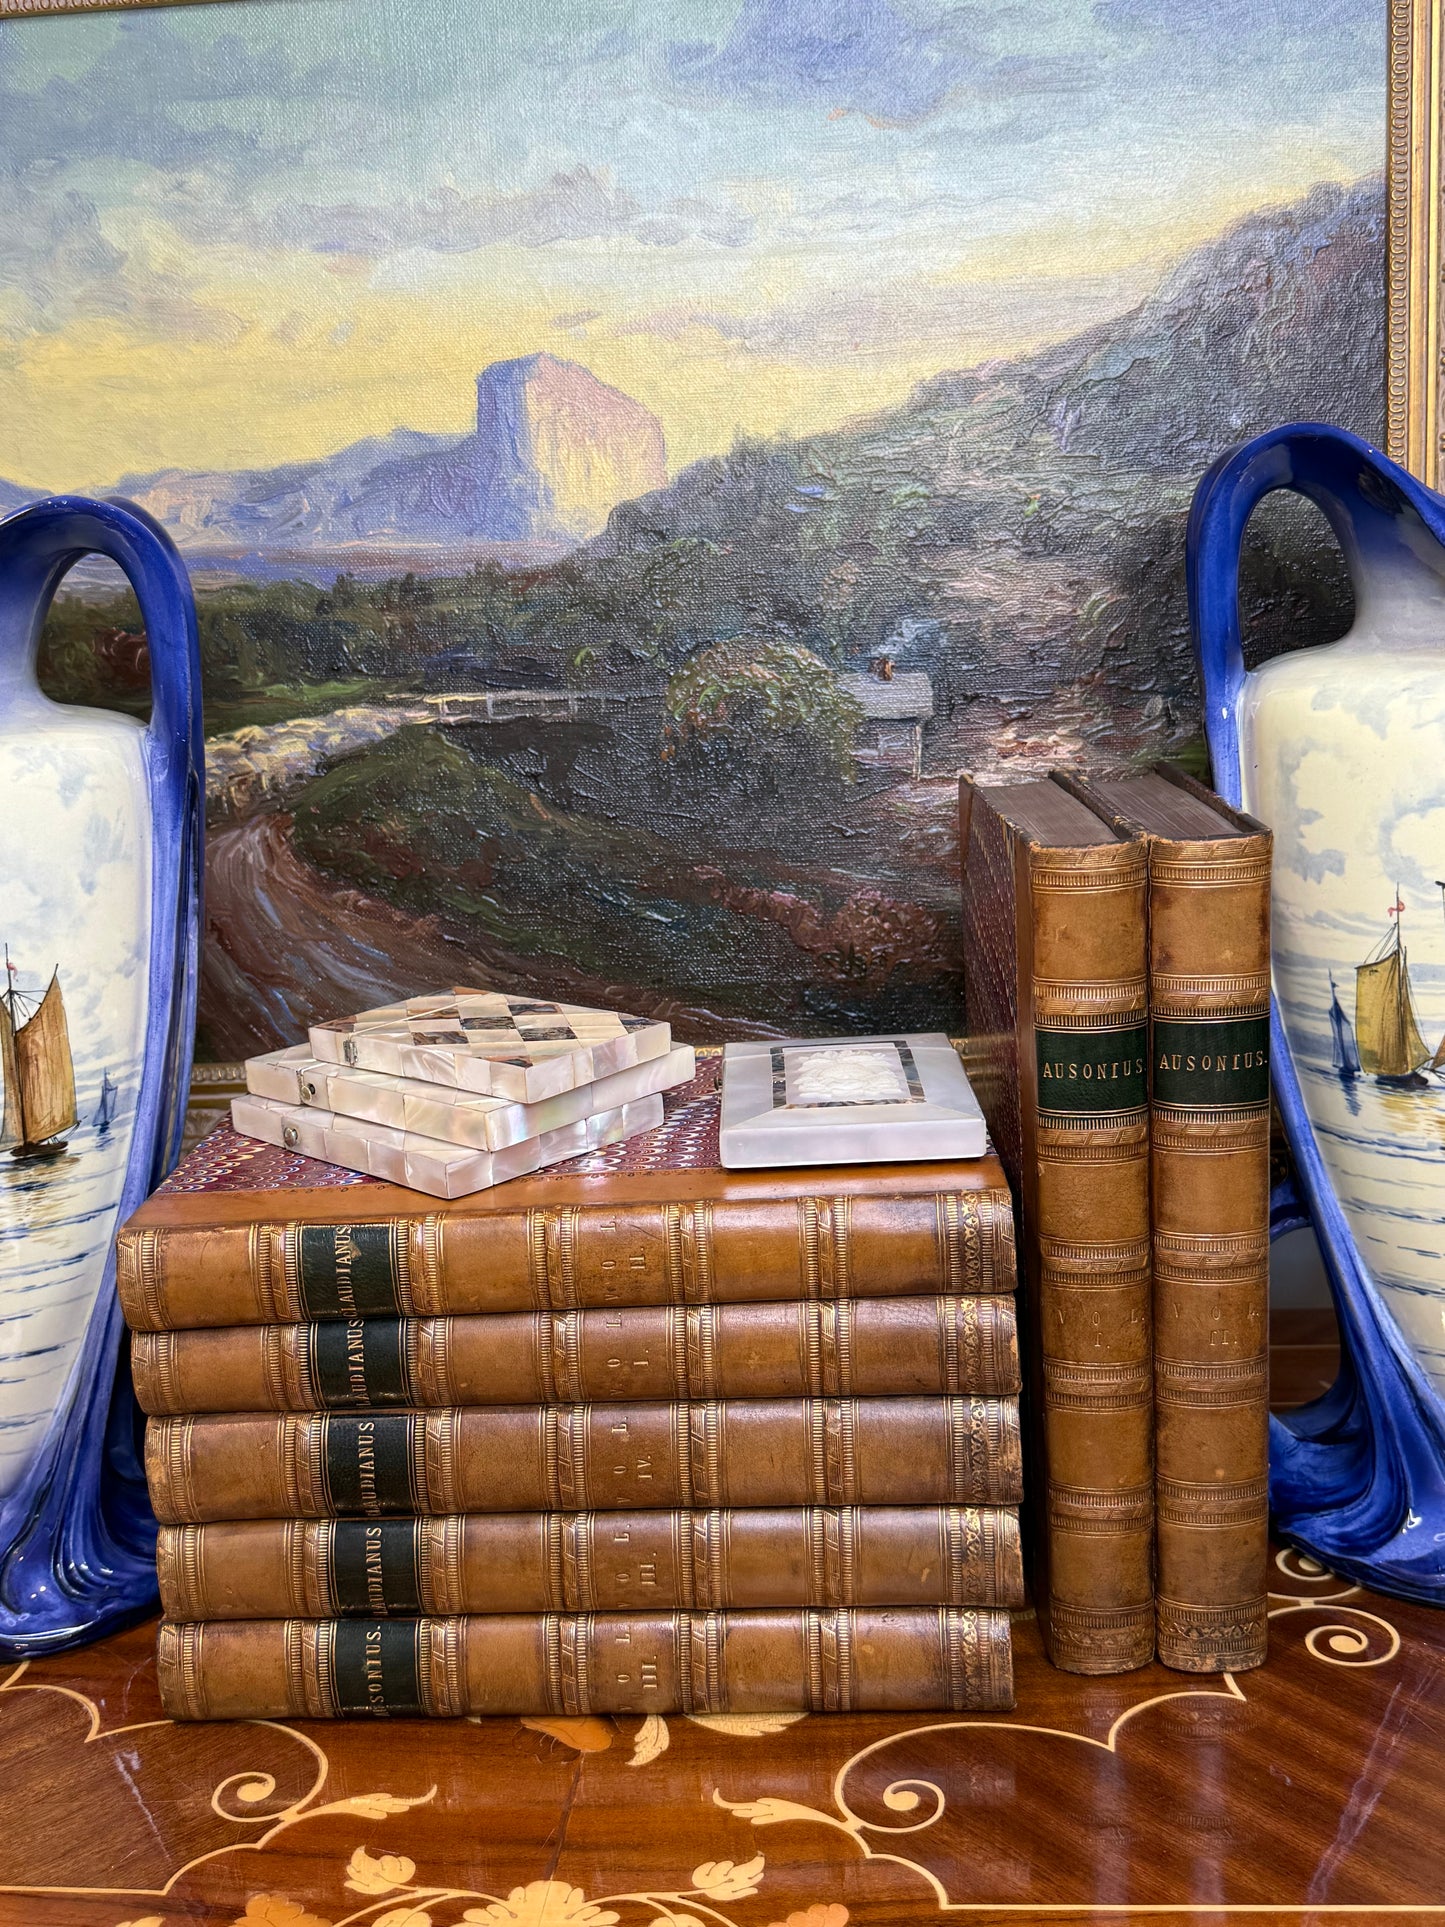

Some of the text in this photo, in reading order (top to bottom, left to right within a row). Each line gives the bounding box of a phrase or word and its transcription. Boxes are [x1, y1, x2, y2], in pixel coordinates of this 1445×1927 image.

[1043, 1058, 1147, 1079] AUSONIUS.
[1159, 1050, 1268, 1072] AUSONIUS.
[334, 1225, 358, 1318] CLAUDIANUS
[347, 1319, 372, 1407] LAUDIANUS
[365, 1526, 389, 1616] LAUDIANUS
